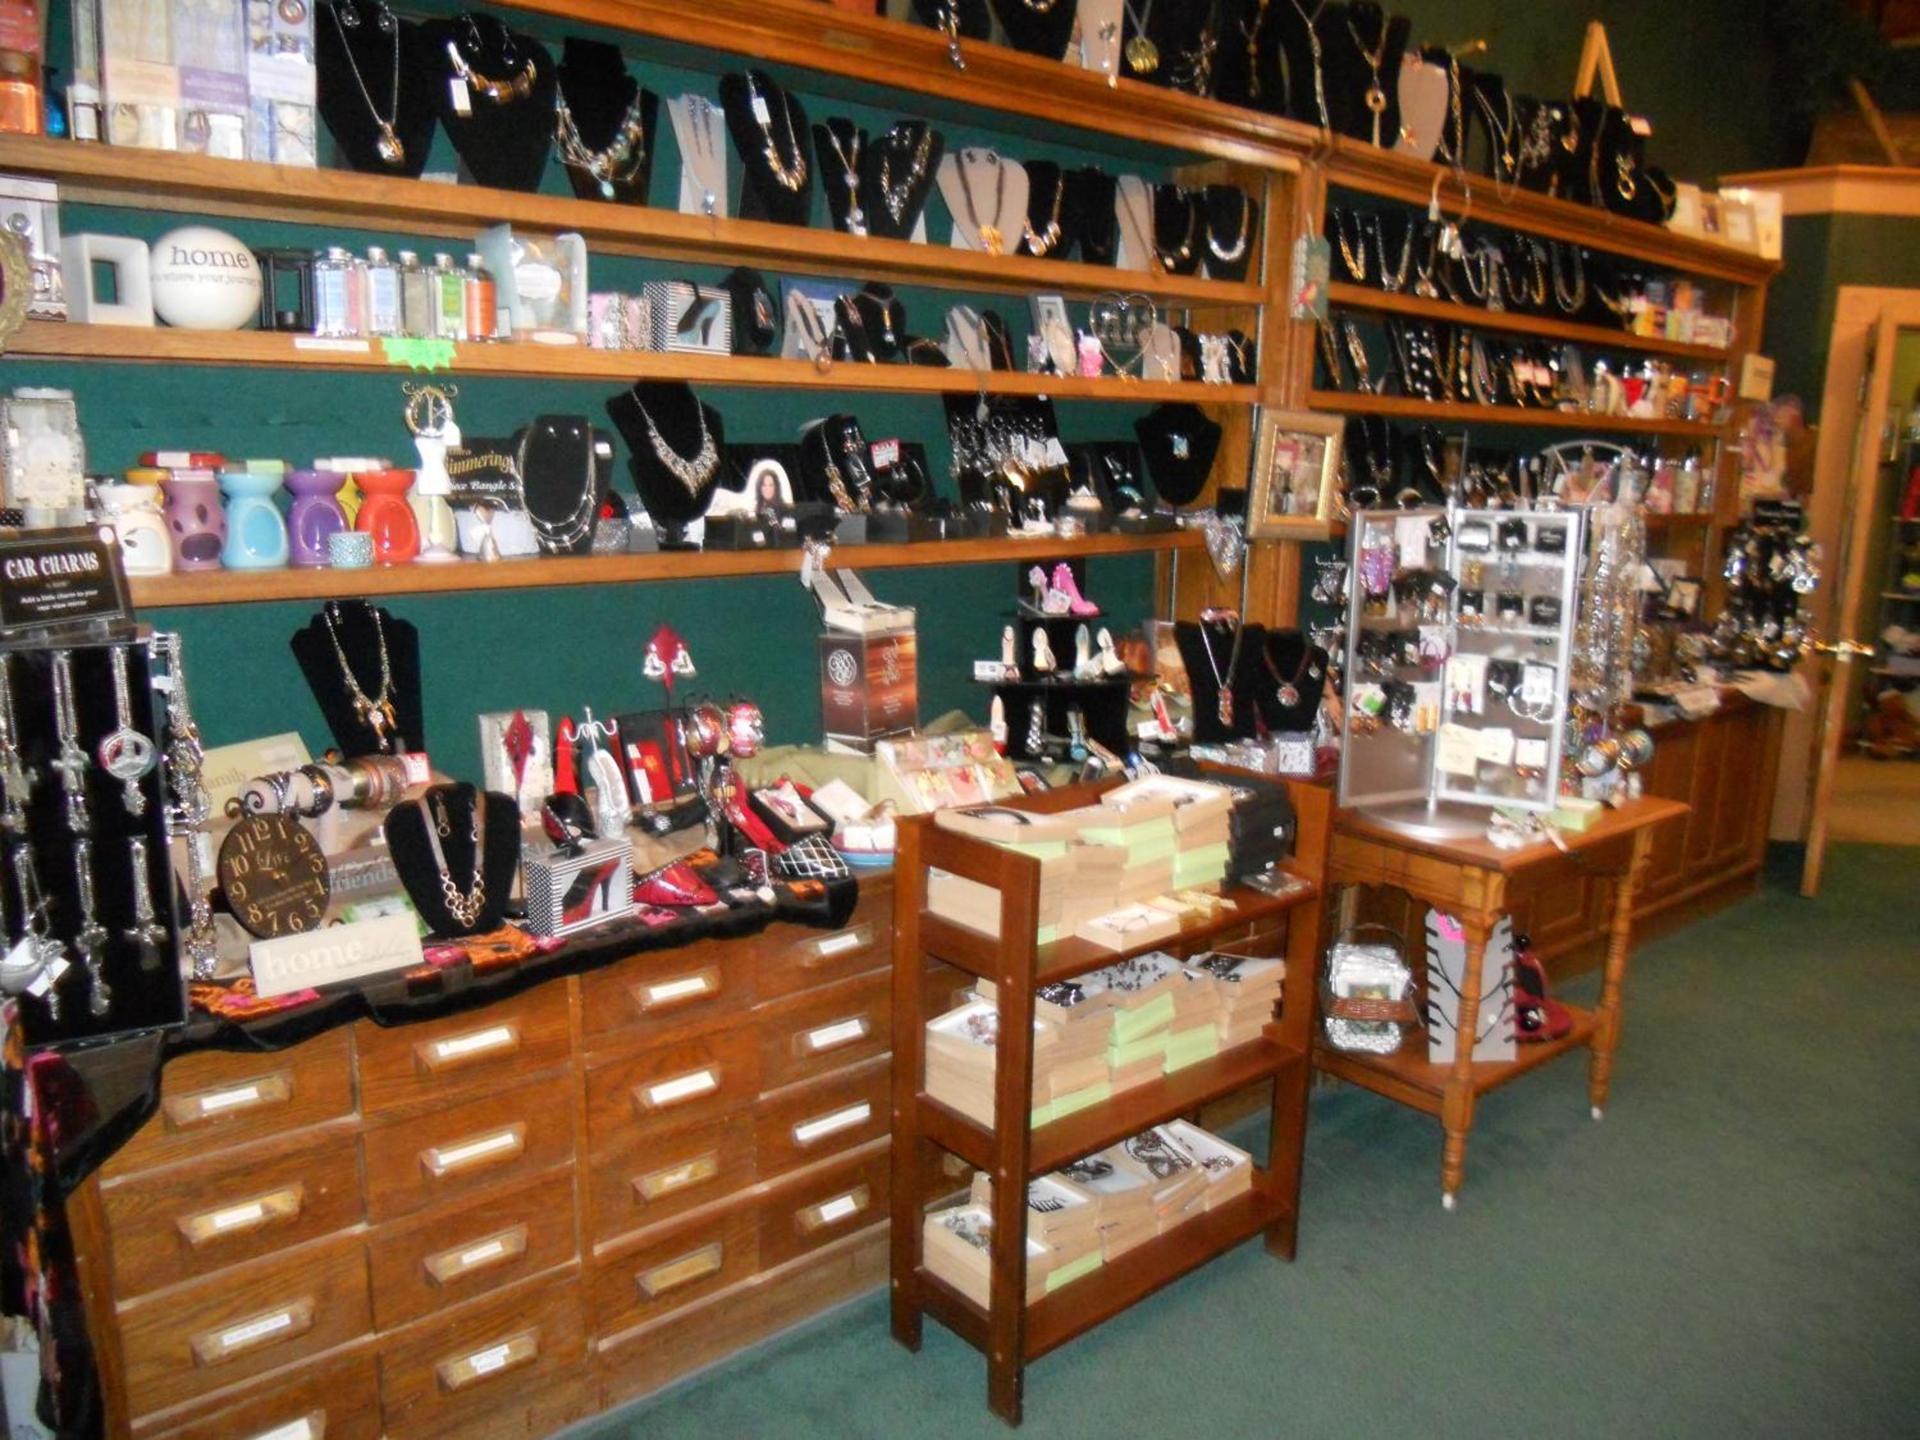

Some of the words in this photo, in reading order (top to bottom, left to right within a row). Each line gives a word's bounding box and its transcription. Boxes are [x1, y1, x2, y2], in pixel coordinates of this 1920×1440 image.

[170, 246, 250, 269] home
[199, 272, 224, 285] your
[470, 480, 508, 492] Bangle
[5, 557, 38, 580] CAR
[41, 552, 99, 575] CHARMS
[252, 818, 271, 841] 12
[278, 818, 287, 839] 1
[236, 832, 256, 853] 11
[294, 832, 310, 853] 2
[230, 854, 250, 878] 10
[309, 853, 324, 873] 3
[231, 880, 247, 901] 9
[247, 903, 263, 924] 8
[304, 898, 319, 918] 5
[267, 910, 279, 935] 7
[288, 911, 304, 931] 6
[263, 941, 362, 978] home
